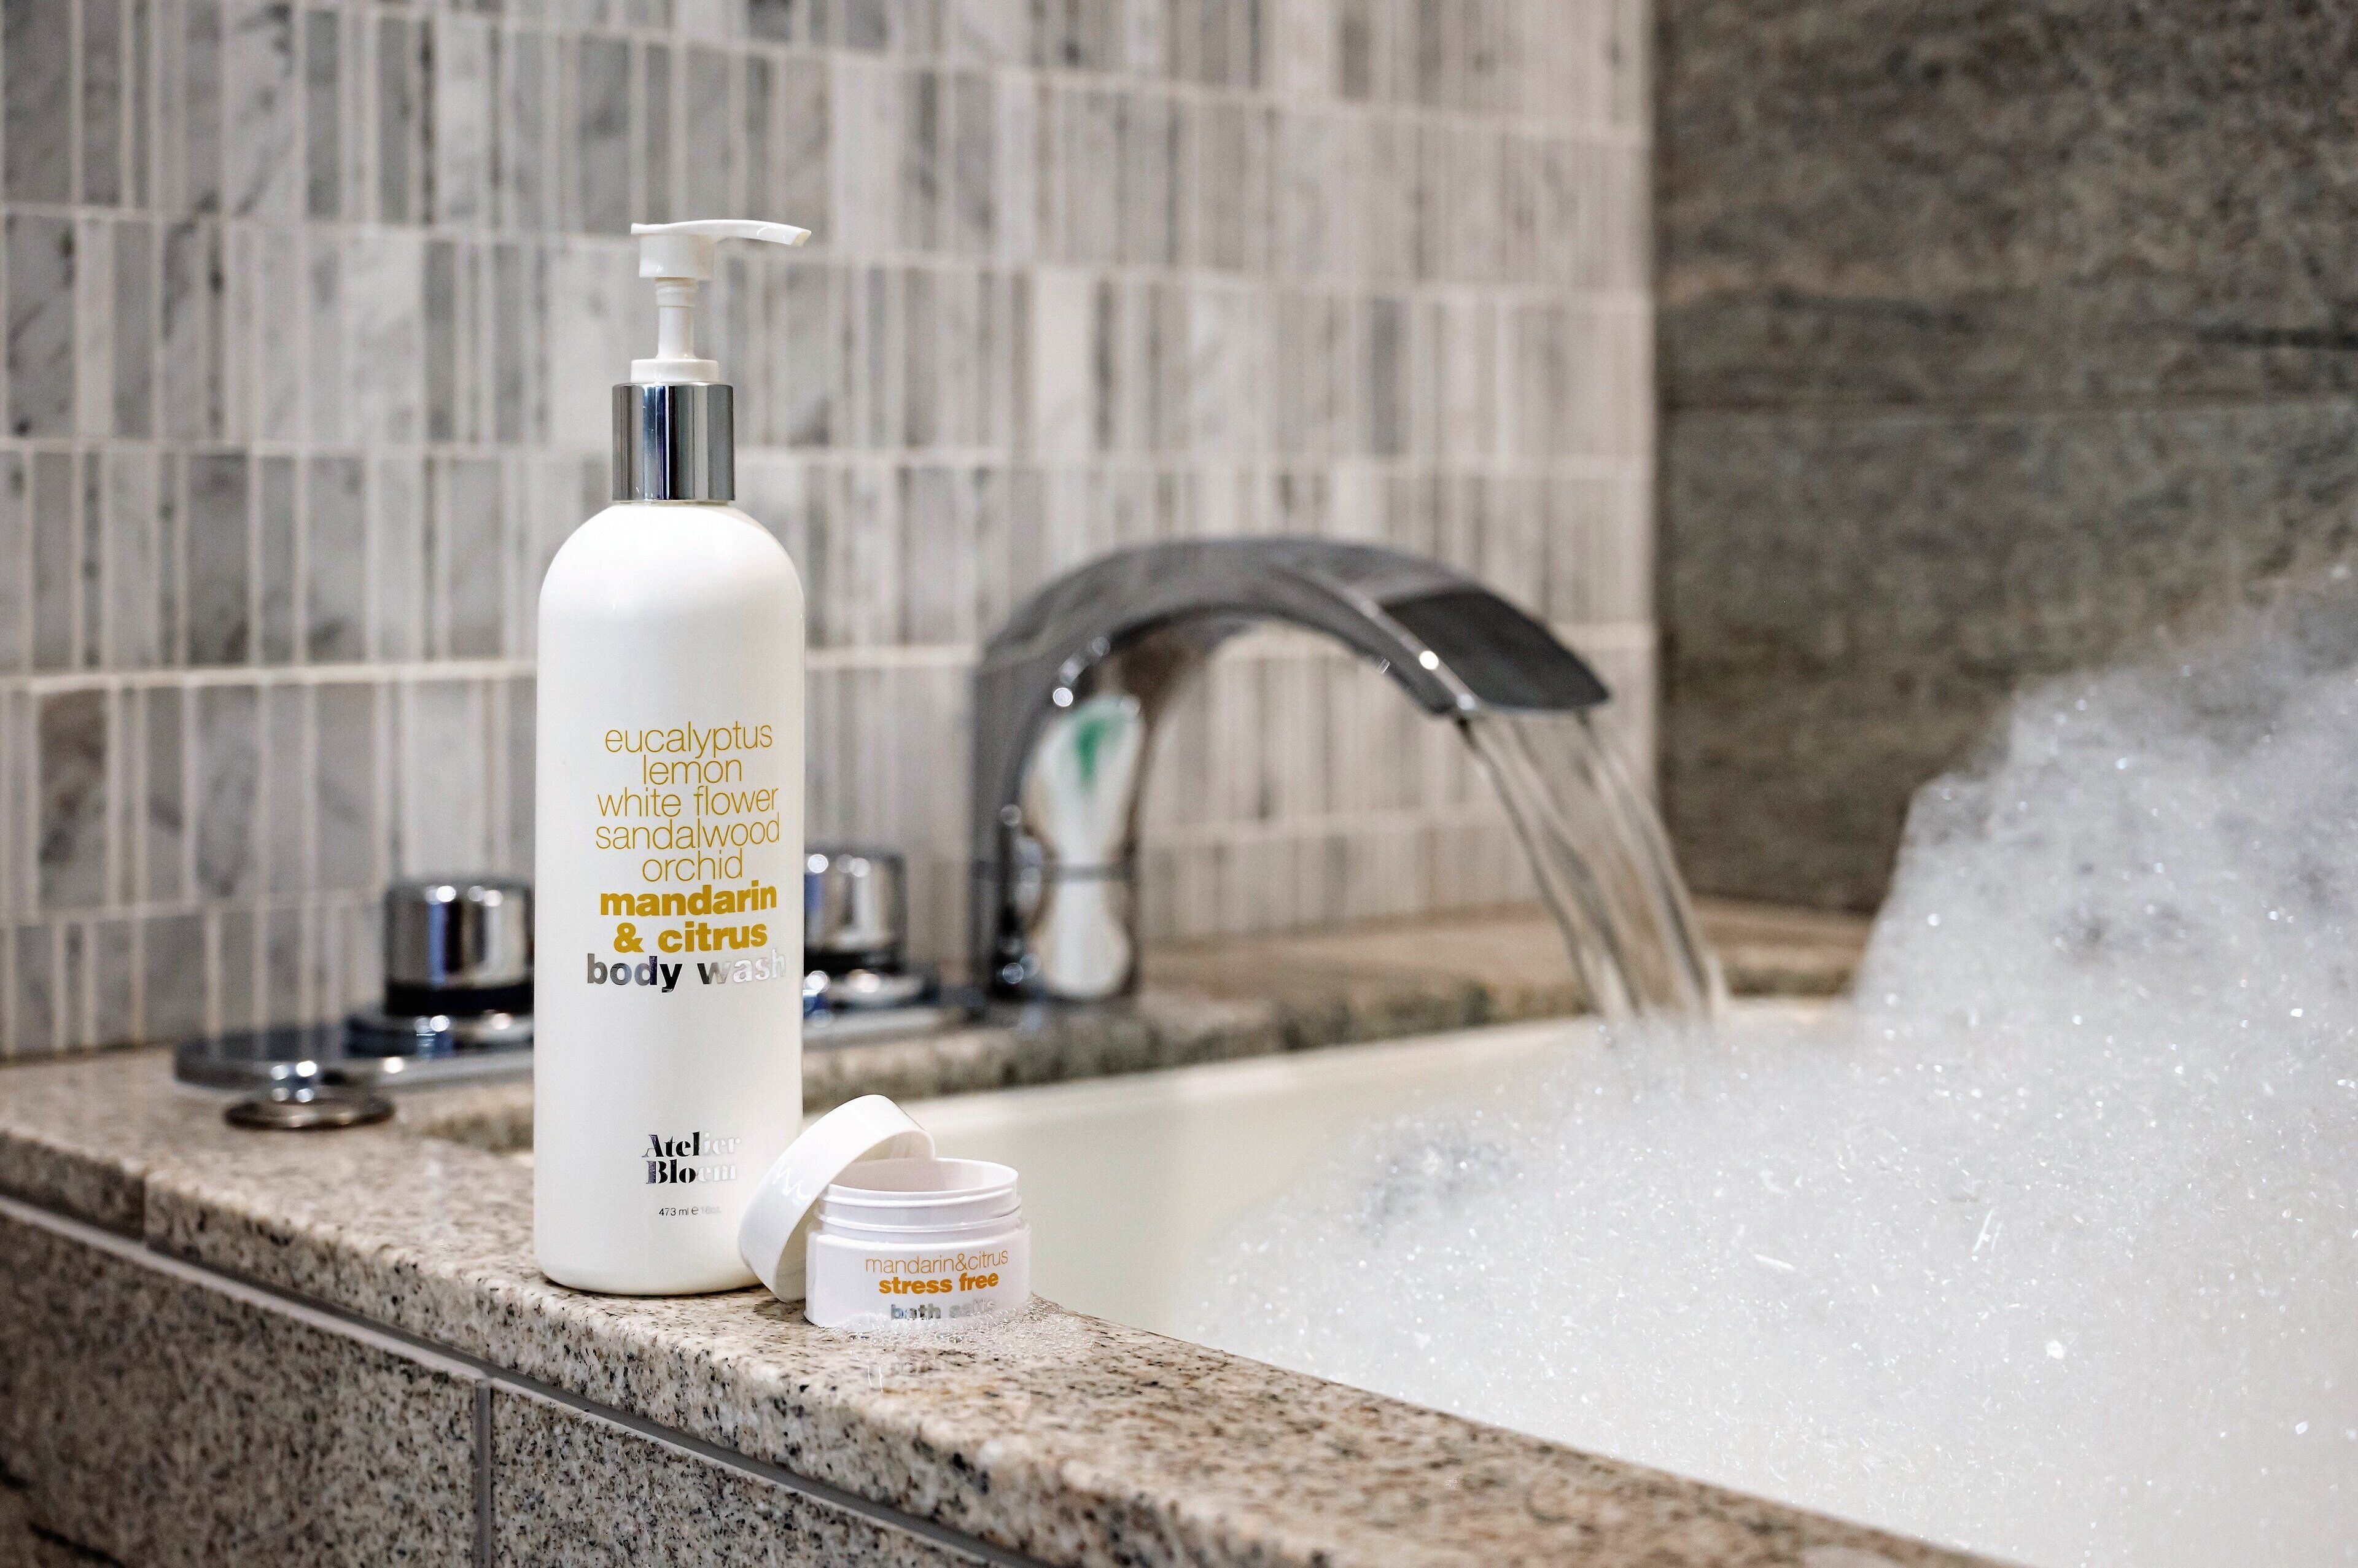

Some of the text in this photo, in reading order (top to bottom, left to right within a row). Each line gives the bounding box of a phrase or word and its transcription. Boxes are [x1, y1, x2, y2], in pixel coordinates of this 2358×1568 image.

[605, 721, 773, 759] eucalyptus
[643, 755, 742, 785] lemon
[597, 785, 779, 817] white flower
[595, 812, 780, 850] sandalwood
[642, 848, 744, 882] orchid
[600, 880, 777, 917] mandarin
[613, 921, 768, 953] & citrus
[586, 949, 787, 993] body wash
[641, 1131, 742, 1158] Atelier
[645, 1159, 737, 1184] Bloem
[658, 1207, 677, 1216] 473
[679, 1206, 689, 1216] ml
[865, 1250, 1009, 1275] mandarin&citrus
[879, 1272, 999, 1295] stress free
